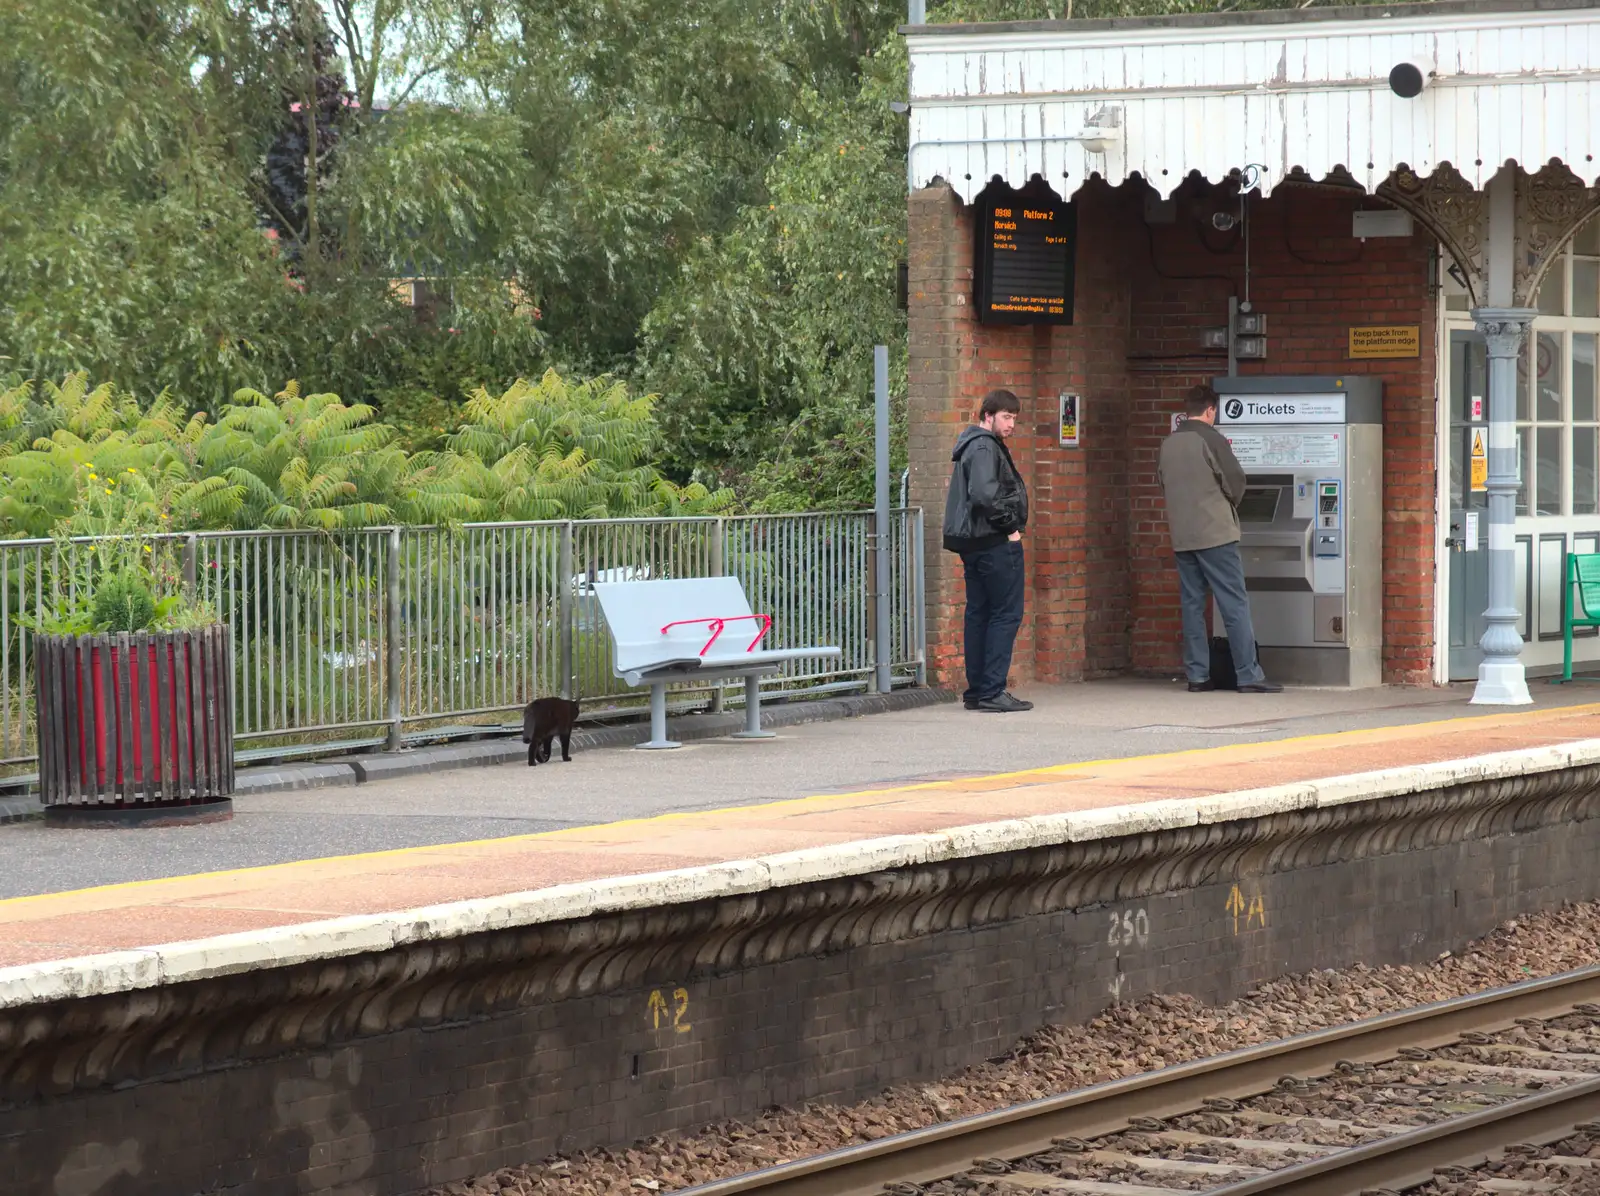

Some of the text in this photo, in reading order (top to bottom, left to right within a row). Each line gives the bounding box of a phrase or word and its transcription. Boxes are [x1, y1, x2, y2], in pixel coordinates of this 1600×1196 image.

[1024, 210, 1048, 220] Platform
[1048, 212, 1054, 220] 2
[994, 220, 1016, 230] Norwich
[1247, 403, 1295, 415] Tickets
[674, 988, 692, 1033] 2
